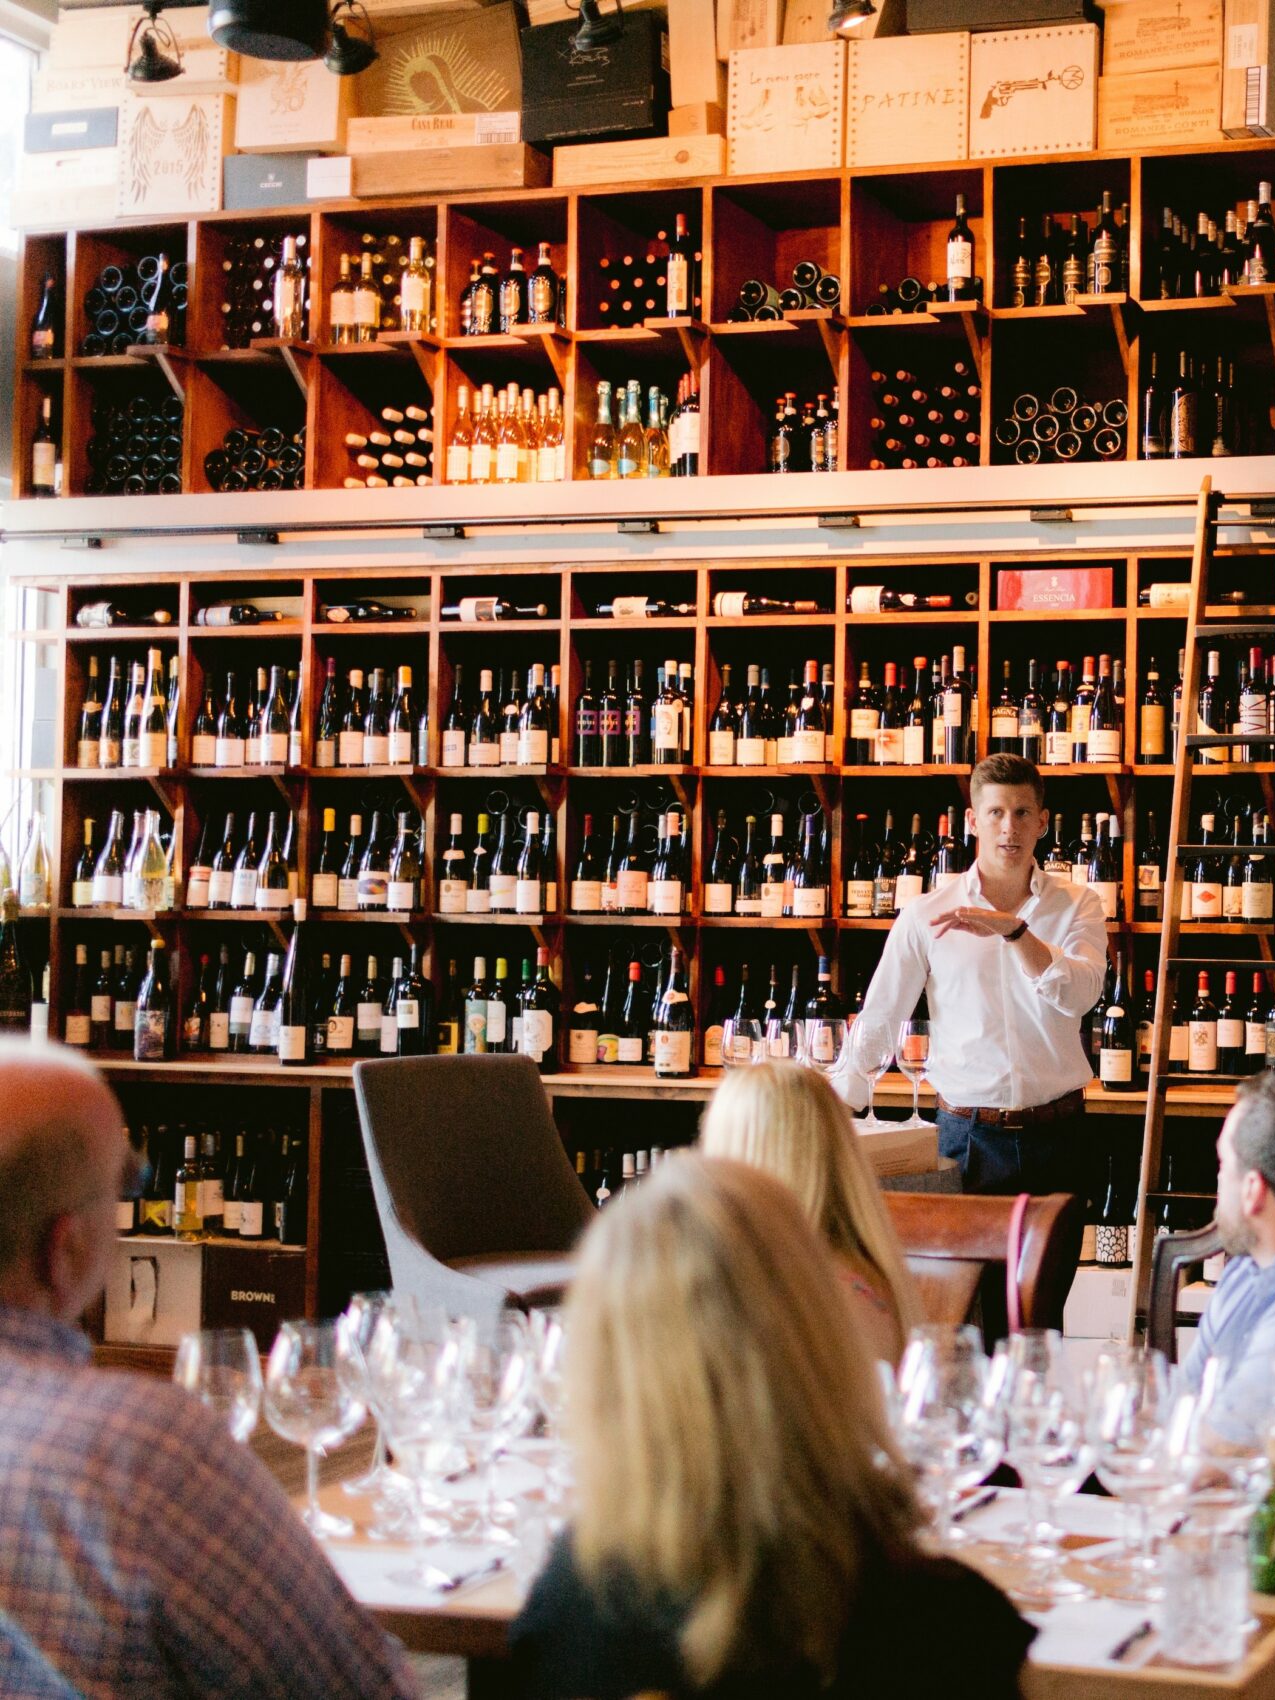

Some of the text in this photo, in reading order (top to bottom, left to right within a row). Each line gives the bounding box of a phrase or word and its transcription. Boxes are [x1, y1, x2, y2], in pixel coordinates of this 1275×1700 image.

[861, 88, 956, 113] PATINE
[153, 160, 184, 176] 2015
[1032, 593, 1076, 603] ESSENCIA
